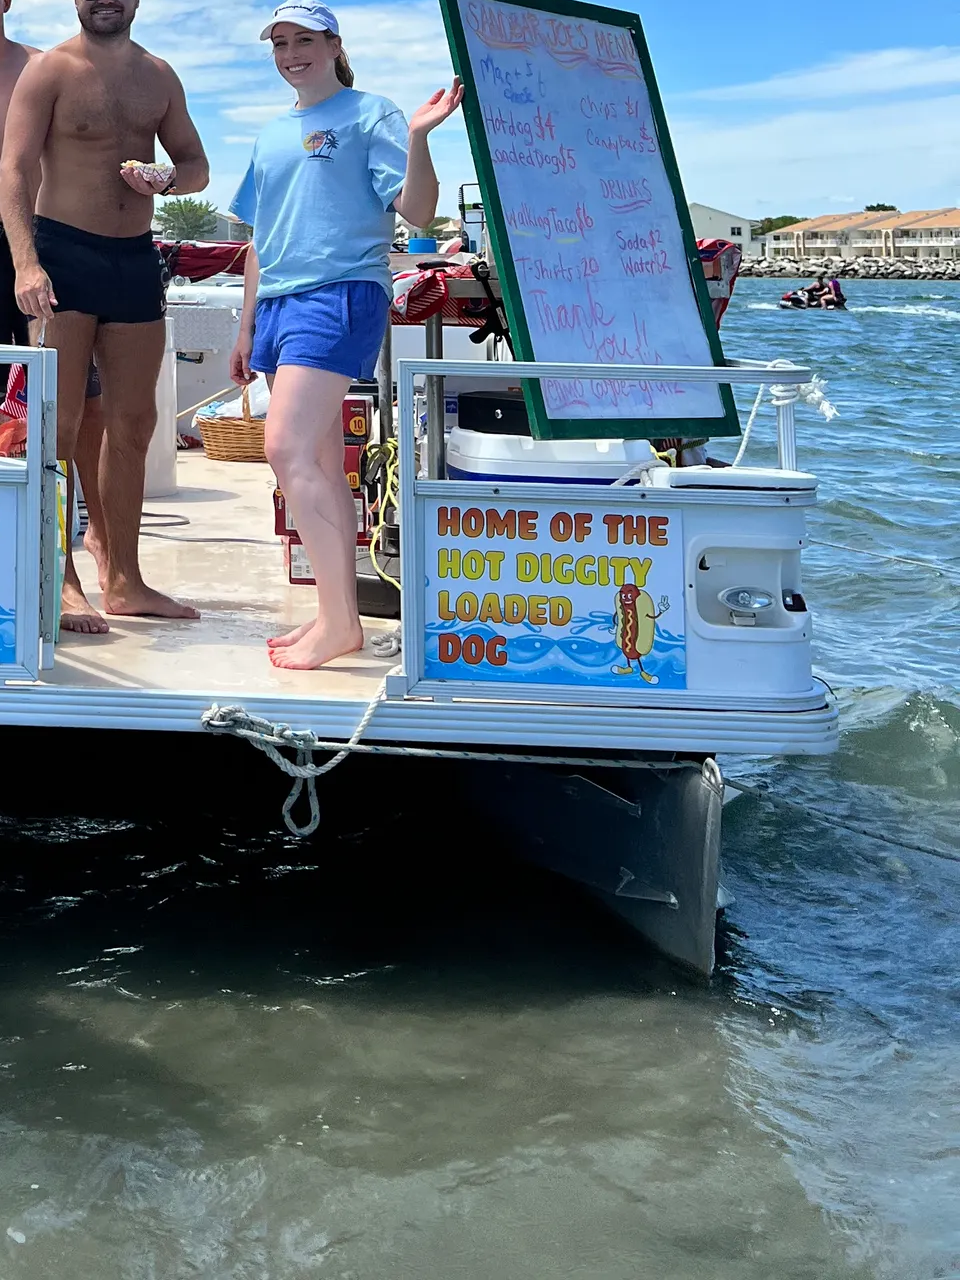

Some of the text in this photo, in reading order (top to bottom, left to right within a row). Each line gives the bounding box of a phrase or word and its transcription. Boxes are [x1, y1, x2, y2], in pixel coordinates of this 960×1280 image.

[580, 96, 616, 119] Chips
[600, 178, 652, 201] DRINKS
[528, 283, 615, 336] Thank
[437, 506, 669, 546] HOME OF THE
[437, 548, 653, 588] HOT DIGGITY
[437, 589, 573, 626] LOADED
[437, 632, 508, 667] DOG
